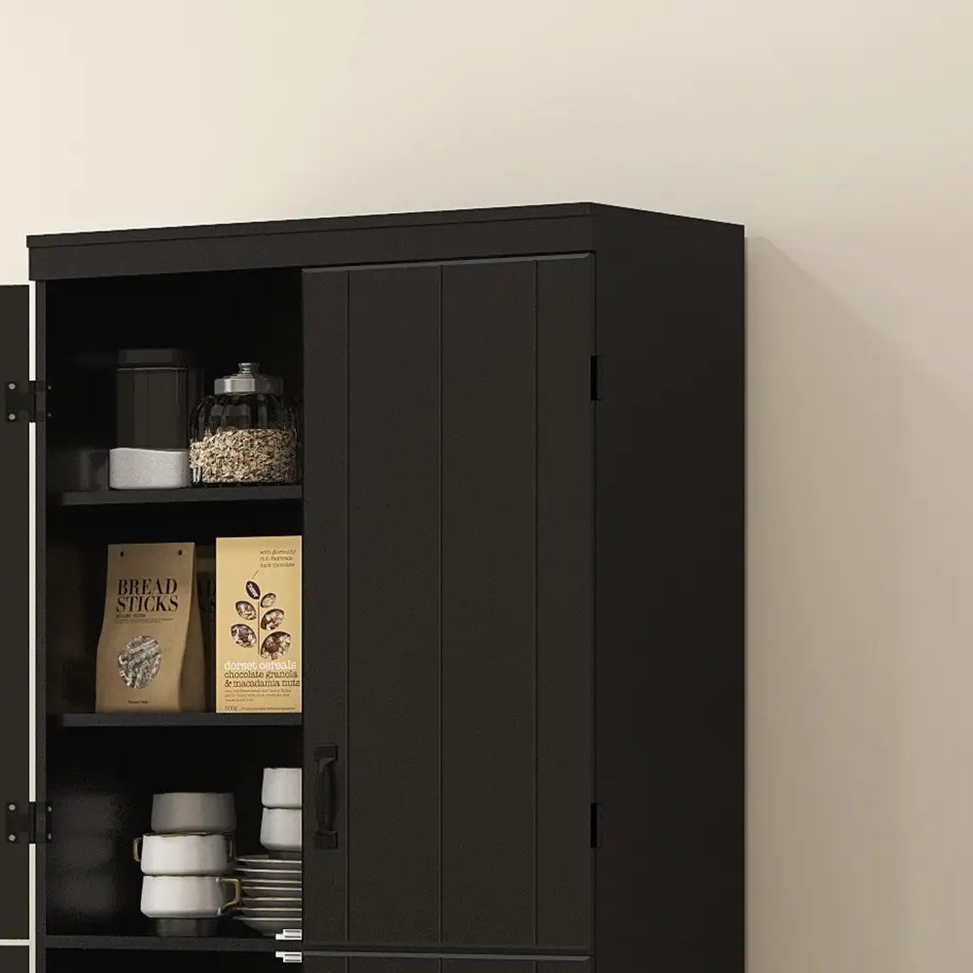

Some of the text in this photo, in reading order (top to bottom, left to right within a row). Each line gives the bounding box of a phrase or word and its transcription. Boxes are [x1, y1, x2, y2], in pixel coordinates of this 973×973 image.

[118, 578, 178, 595] BREAD
[116, 595, 179, 612] STICKS
[224, 660, 297, 670] dorset cereals
[224, 670, 298, 680] chocolate granola
[224, 679, 301, 688] & macadamia nuts
